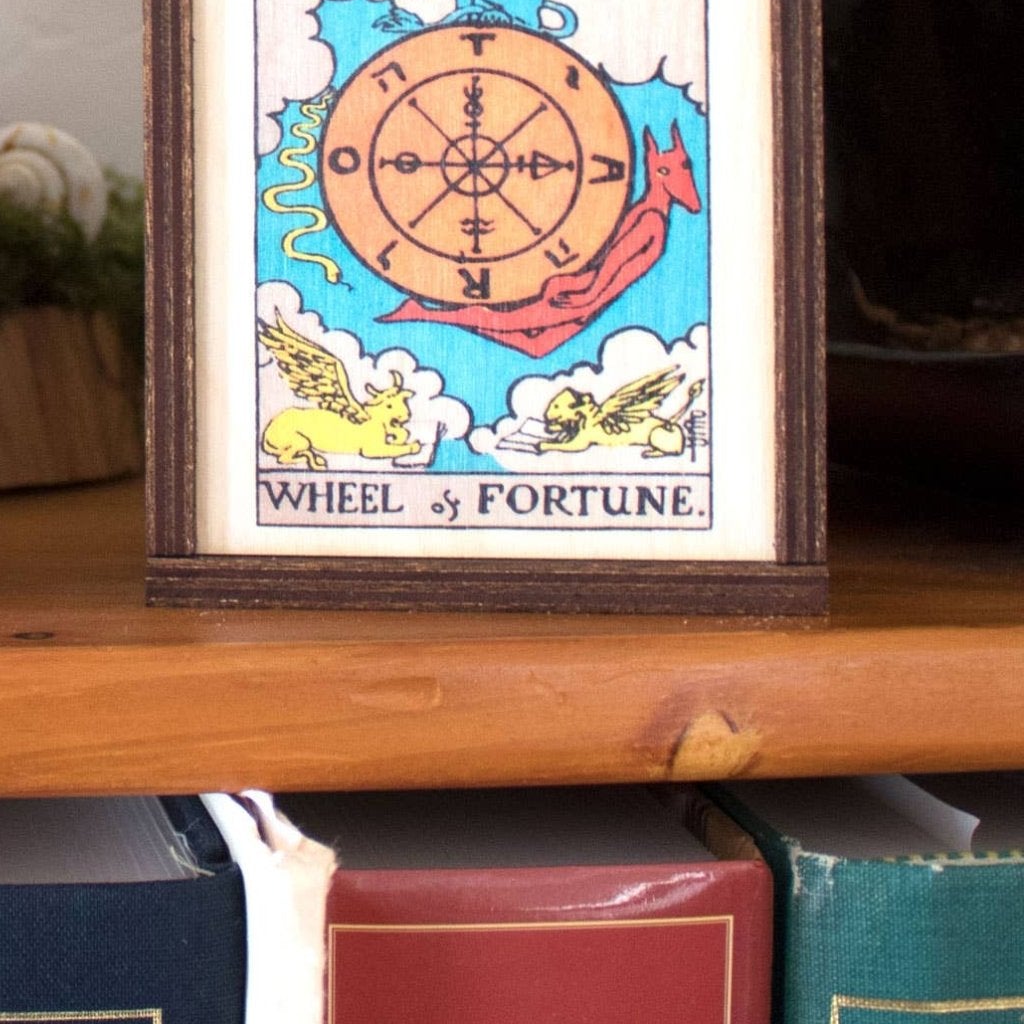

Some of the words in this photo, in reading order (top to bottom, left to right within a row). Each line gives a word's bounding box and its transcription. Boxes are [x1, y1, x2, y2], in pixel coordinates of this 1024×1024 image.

[460, 32, 497, 57] T
[588, 154, 625, 185] A
[260, 481, 404, 515] WHEEL
[430, 489, 461, 522] of
[478, 483, 706, 517] FORTUNE.
